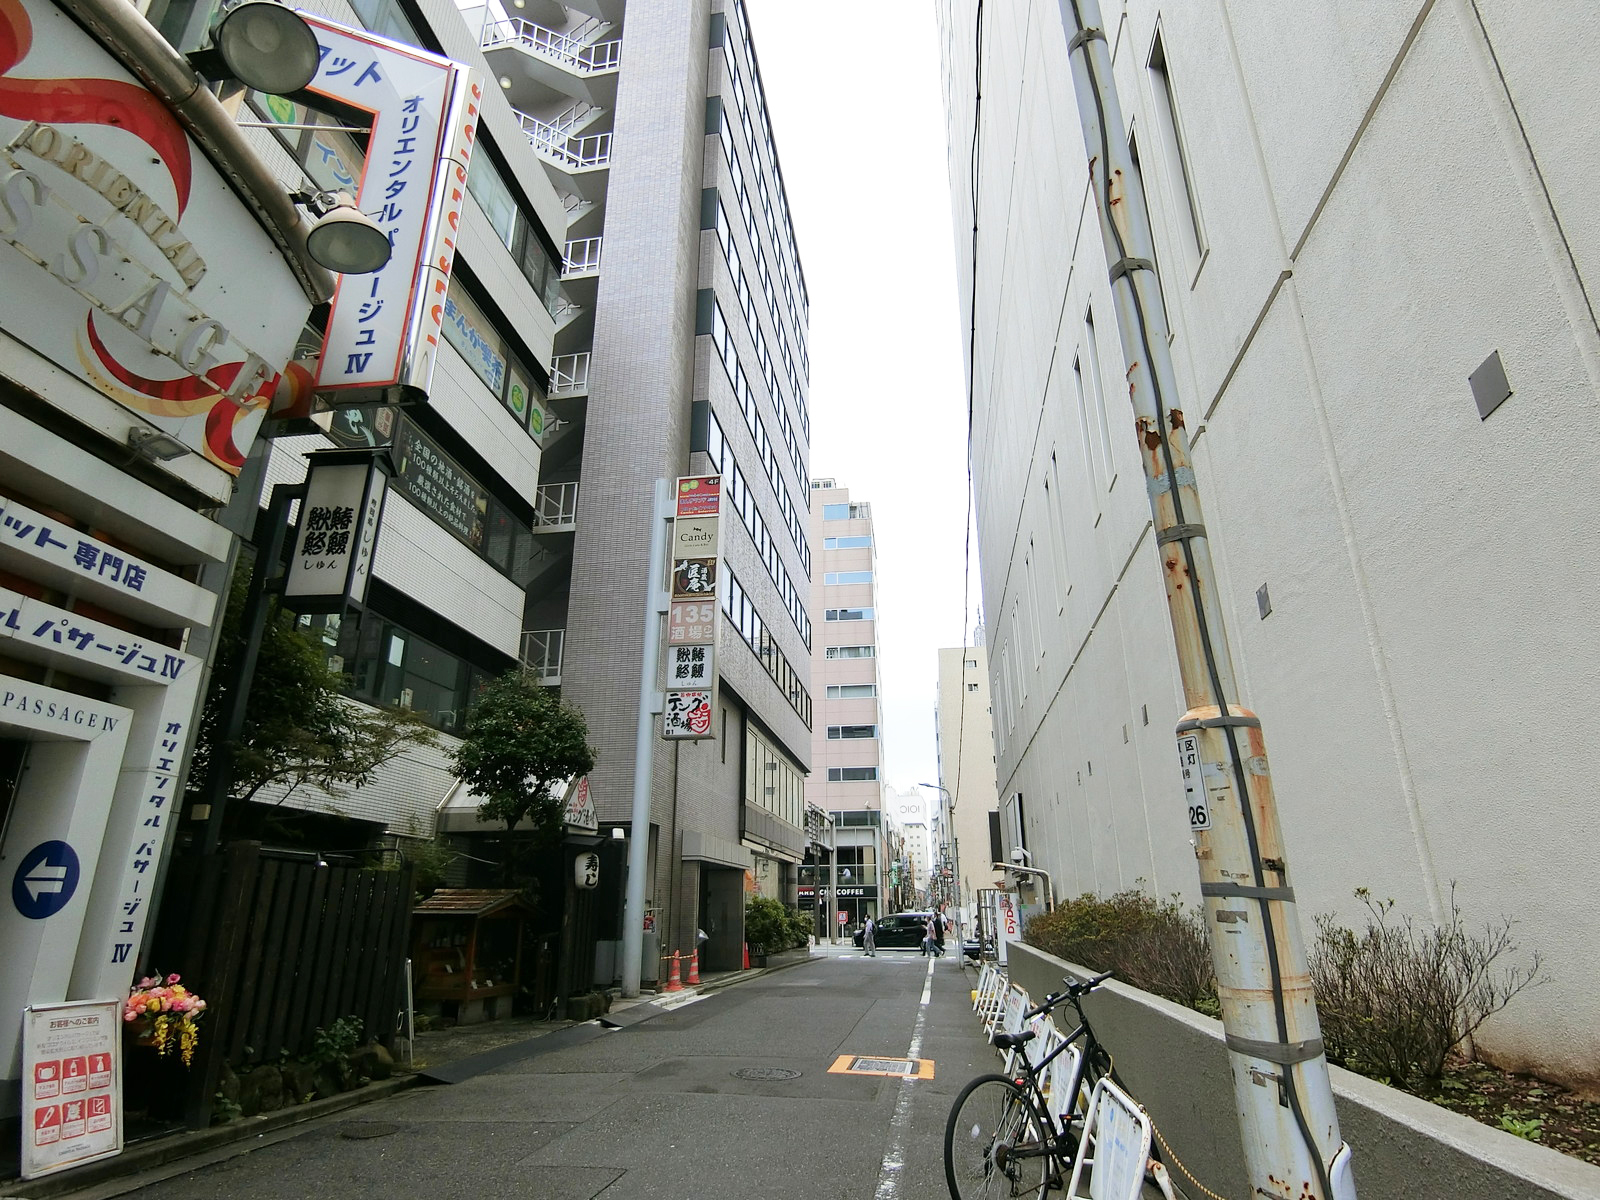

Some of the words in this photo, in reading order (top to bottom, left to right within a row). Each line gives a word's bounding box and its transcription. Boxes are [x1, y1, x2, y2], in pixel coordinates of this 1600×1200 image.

[31, 125, 208, 290] ORIENTAL
[345, 95, 424, 375] オリエンタルパージュIV
[708, 478, 720, 486] 4F
[680, 532, 714, 543] Candy
[0, 508, 148, 592] ット専門店
[303, 559, 338, 571] しゅん
[671, 604, 714, 624] 135
[671, 625, 702, 640] 酒場
[2, 691, 98, 728] PASSAGE
[101, 716, 120, 732] IV
[667, 693, 709, 713] テング
[1189, 805, 1207, 825] 26
[584, 854, 599, 888] 寿し
[836, 888, 864, 896] COFFEE
